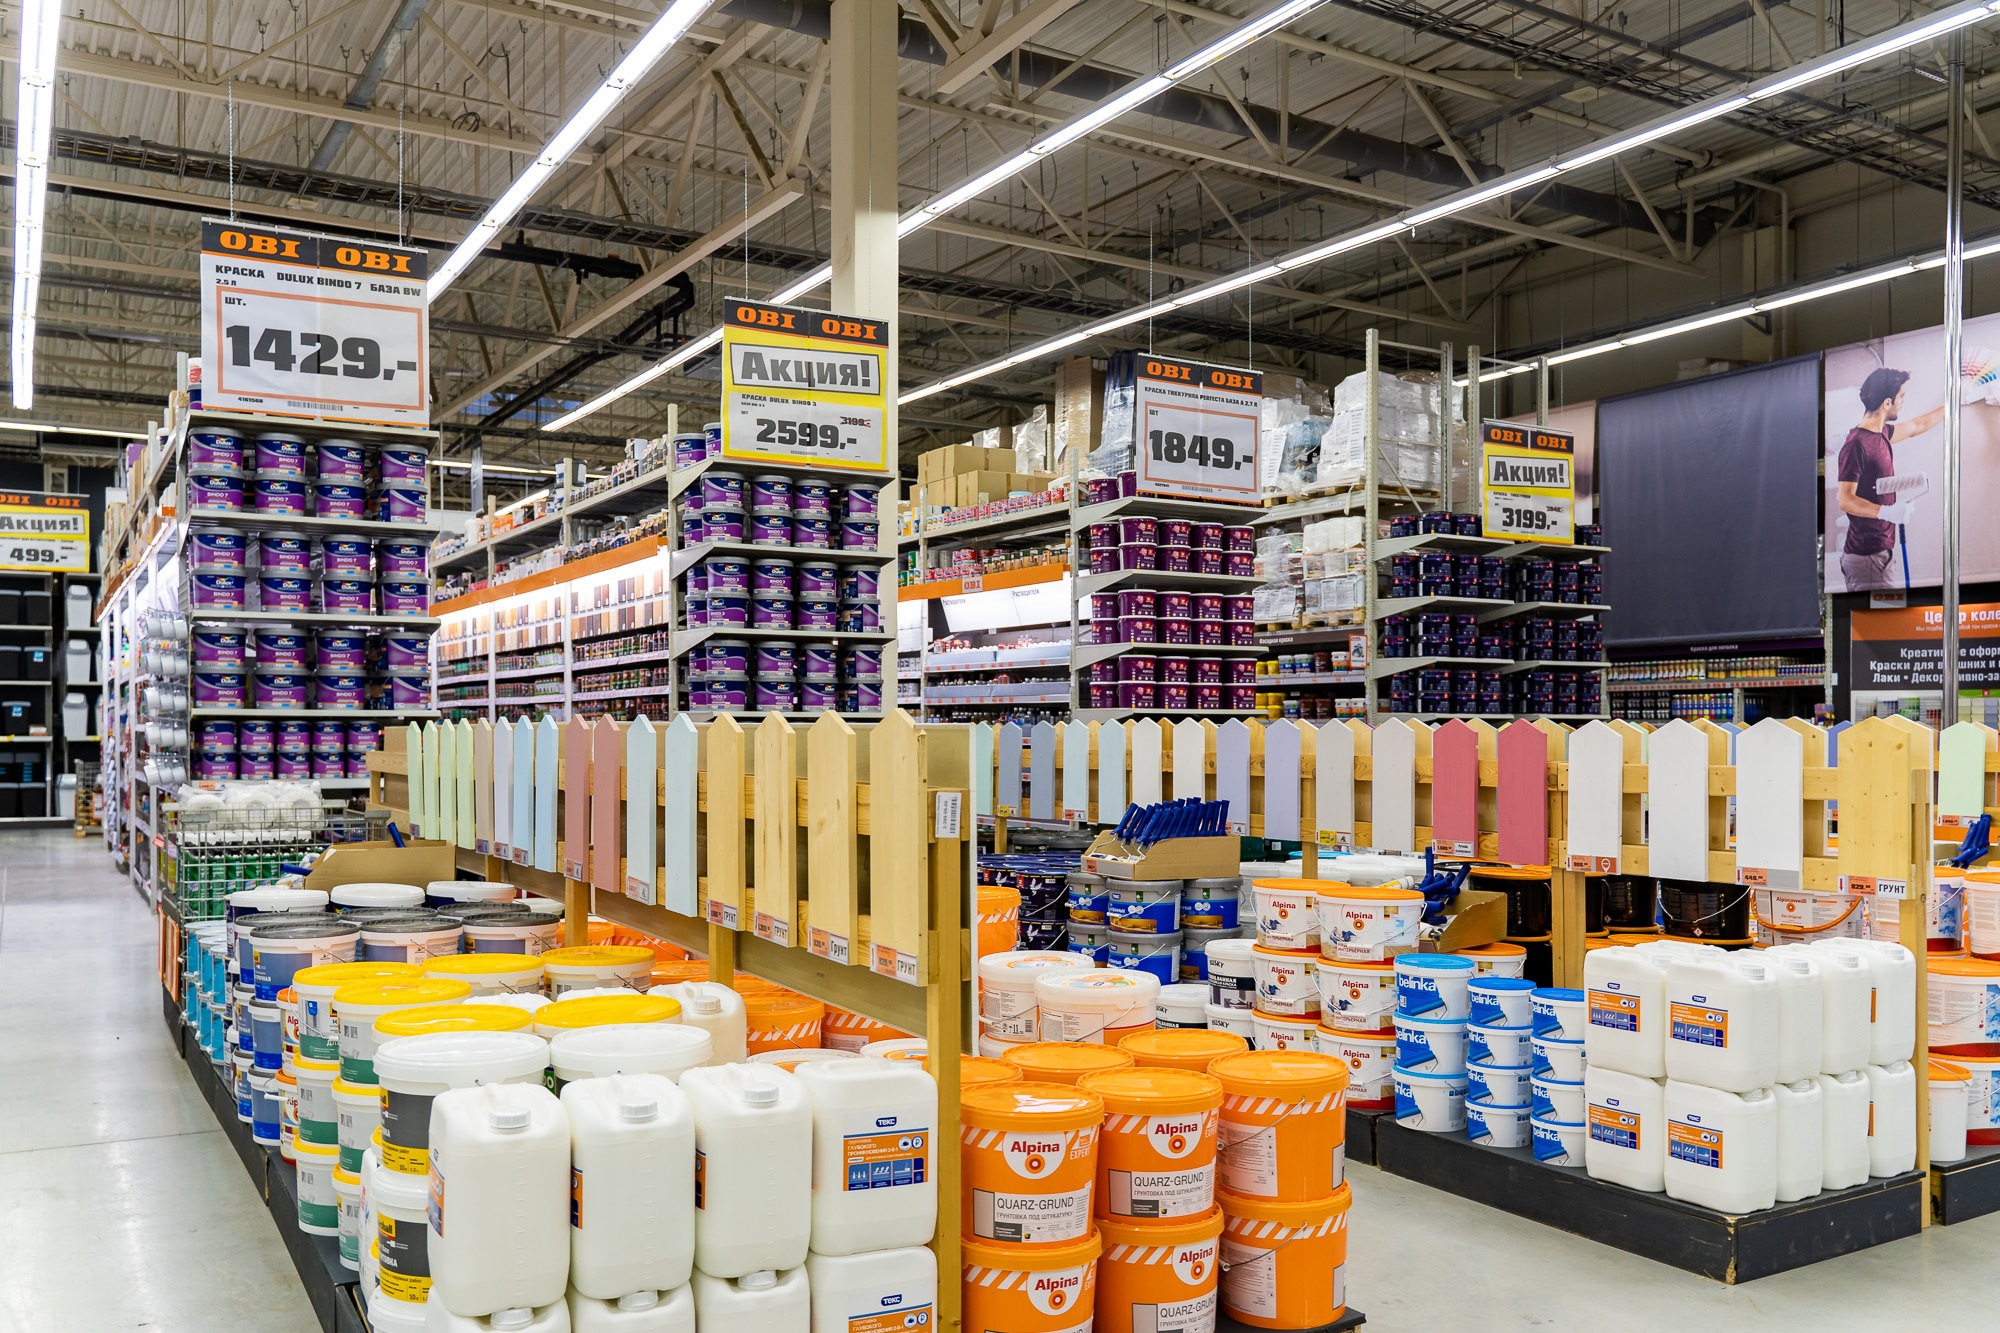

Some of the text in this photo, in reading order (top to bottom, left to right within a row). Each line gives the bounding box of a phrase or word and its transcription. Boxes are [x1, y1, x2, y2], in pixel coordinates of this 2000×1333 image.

[219, 230, 412, 273] OBI OBI
[215, 264, 422, 297] КРАСКА DULUX BINDO 7 БАЗА BW
[215, 278, 229, 286] 2.5
[224, 296, 247, 307] ШТ.
[736, 306, 878, 340] OBI OBI
[741, 351, 871, 388] Акция!
[1146, 361, 1254, 390] OBI OBI
[741, 393, 767, 402] КРАСКА
[769, 396, 790, 404] DULUX
[1144, 386, 1167, 395] КРАСКА
[1167, 390, 1199, 399] ТИККУРИЛА
[1490, 428, 1568, 450] OBI OBI
[1493, 460, 1565, 485] Акция!
[45, 497, 80, 507] OBI
[0, 516, 79, 533] Акция!
[963, 580, 981, 590] OBI
[1869, 660, 1911, 672] Краски
[1913, 661, 1934, 672] для
[1872, 672, 1901, 683] Лаки
[1878, 883, 1906, 894] ГРУНТ
[1272, 900, 1297, 911] Alpina
[723, 908, 737, 924] ГРУНТ
[1345, 911, 1373, 922] Alpina
[773, 925, 788, 940] ГРУНТ
[830, 940, 848, 957] Грунт
[897, 959, 916, 976] ГРУНТ
[1271, 966, 1295, 977] Alpina
[1342, 979, 1370, 991] Alpina
[1399, 975, 1437, 992] belinka
[1471, 993, 1499, 1006] belinka
[1270, 1031, 1295, 1042] Alpina
[1343, 1049, 1371, 1061] Alpina
[1154, 1122, 1198, 1138] Alpina
[1010, 1140, 1060, 1157] Alpina
[1133, 1171, 1204, 1188] QUARZ-GRUND
[1133, 1185, 1204, 1197] ГРУНТОВКА ПОД ШТУКАТУРКУ
[996, 1196, 1075, 1211] QUARZ-GRUND
[996, 1212, 1028, 1220] ГРУНТОВКА
[1041, 1211, 1073, 1220] ШТУКАТУРКУ
[1178, 1246, 1214, 1265] Alpina
[1034, 1276, 1079, 1293] Alpina
[1159, 1319, 1188, 1328] ГРУНТОВКА
